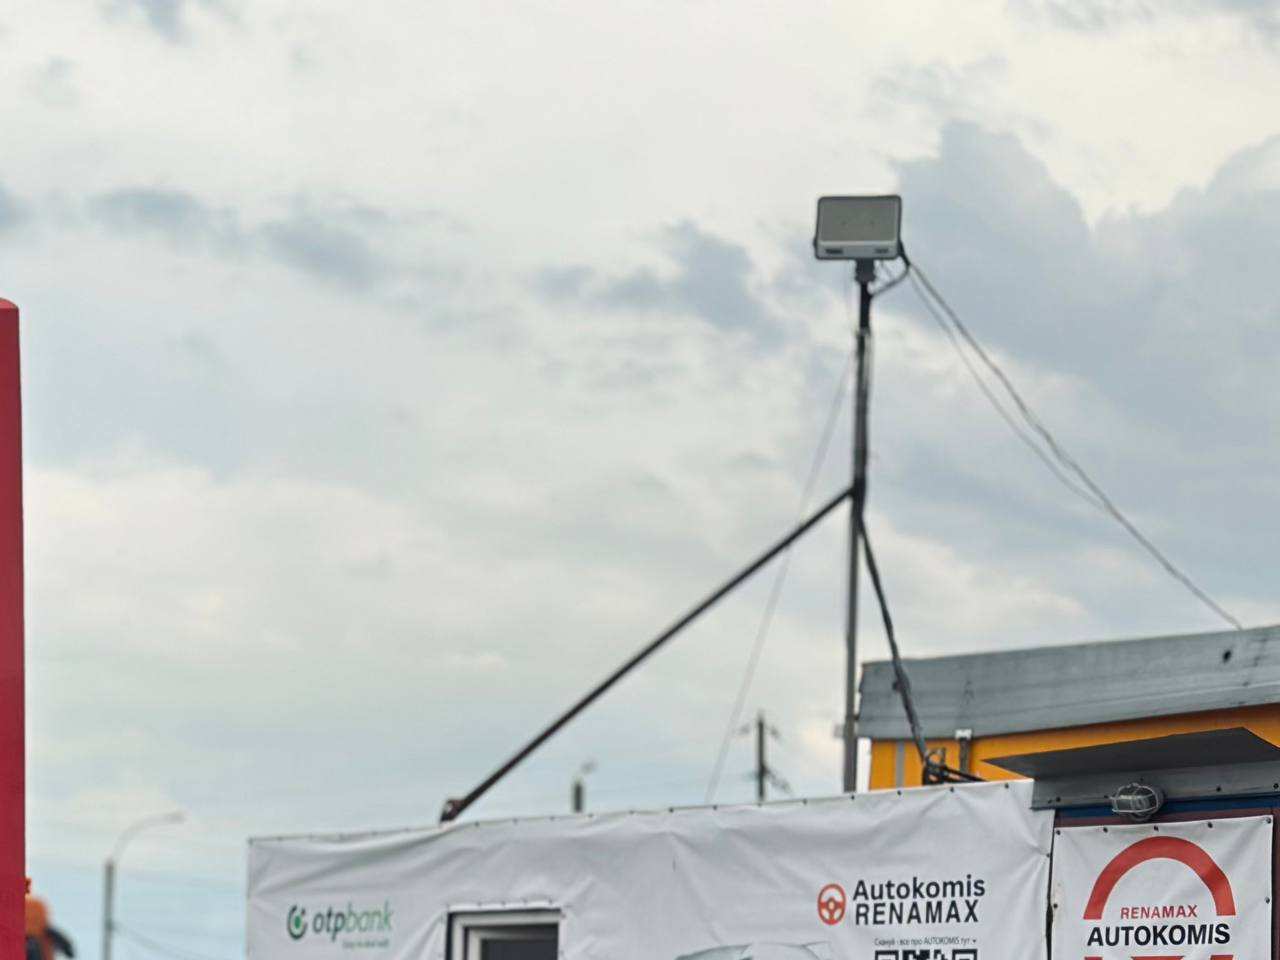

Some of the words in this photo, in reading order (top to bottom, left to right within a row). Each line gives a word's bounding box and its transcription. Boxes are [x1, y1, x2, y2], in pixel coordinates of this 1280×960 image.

[853, 874, 986, 901] Autokomis
[312, 900, 394, 943] otpbank
[855, 900, 979, 926] RENAMAX
[1121, 905, 1198, 919] RENAMAX
[1087, 923, 1231, 946] AUTOKOMIS
